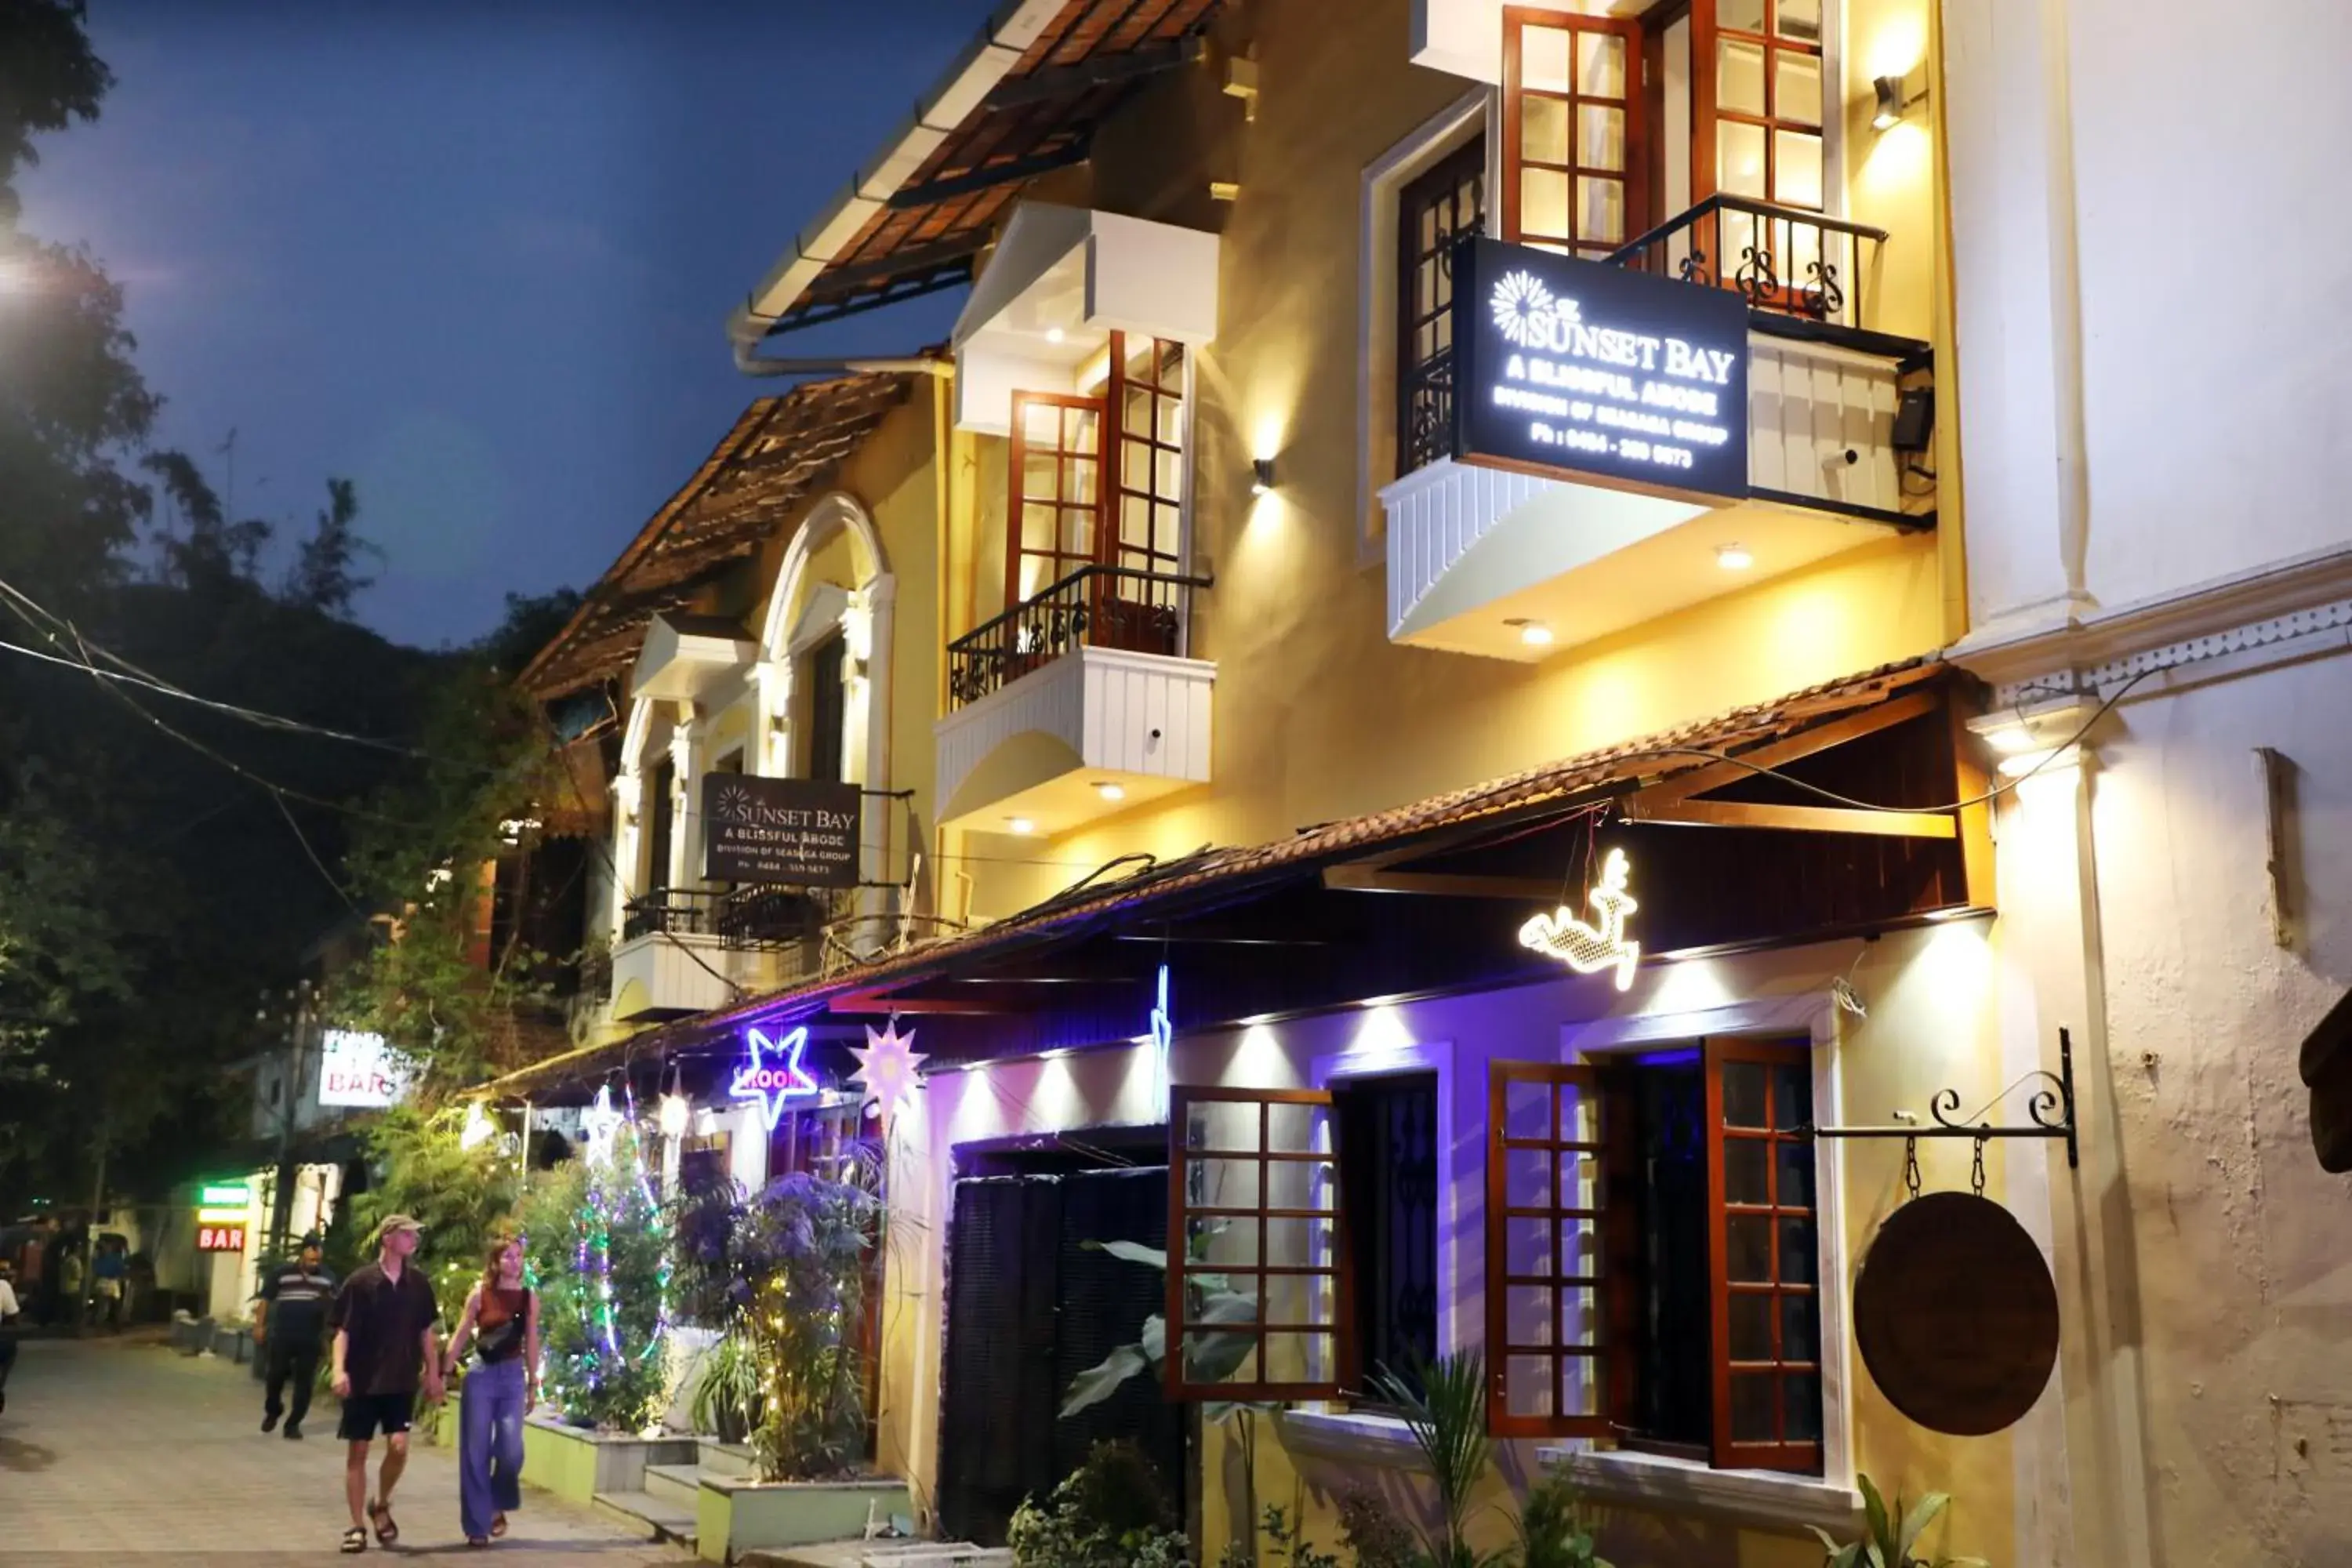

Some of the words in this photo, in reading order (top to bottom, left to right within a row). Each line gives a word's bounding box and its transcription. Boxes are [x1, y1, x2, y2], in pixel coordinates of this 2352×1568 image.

[1526, 310, 1660, 370] SUNSET
[1664, 338, 1734, 384] BAY
[1506, 354, 1525, 379] A
[736, 804, 812, 826] SUNSET
[816, 809, 855, 829] BAY
[724, 828, 734, 838] A
[738, 828, 798, 843] BLISSFUL
[800, 830, 845, 846] ABODE
[819, 851, 851, 862] GROUP
[199, 1229, 243, 1249] BAR
